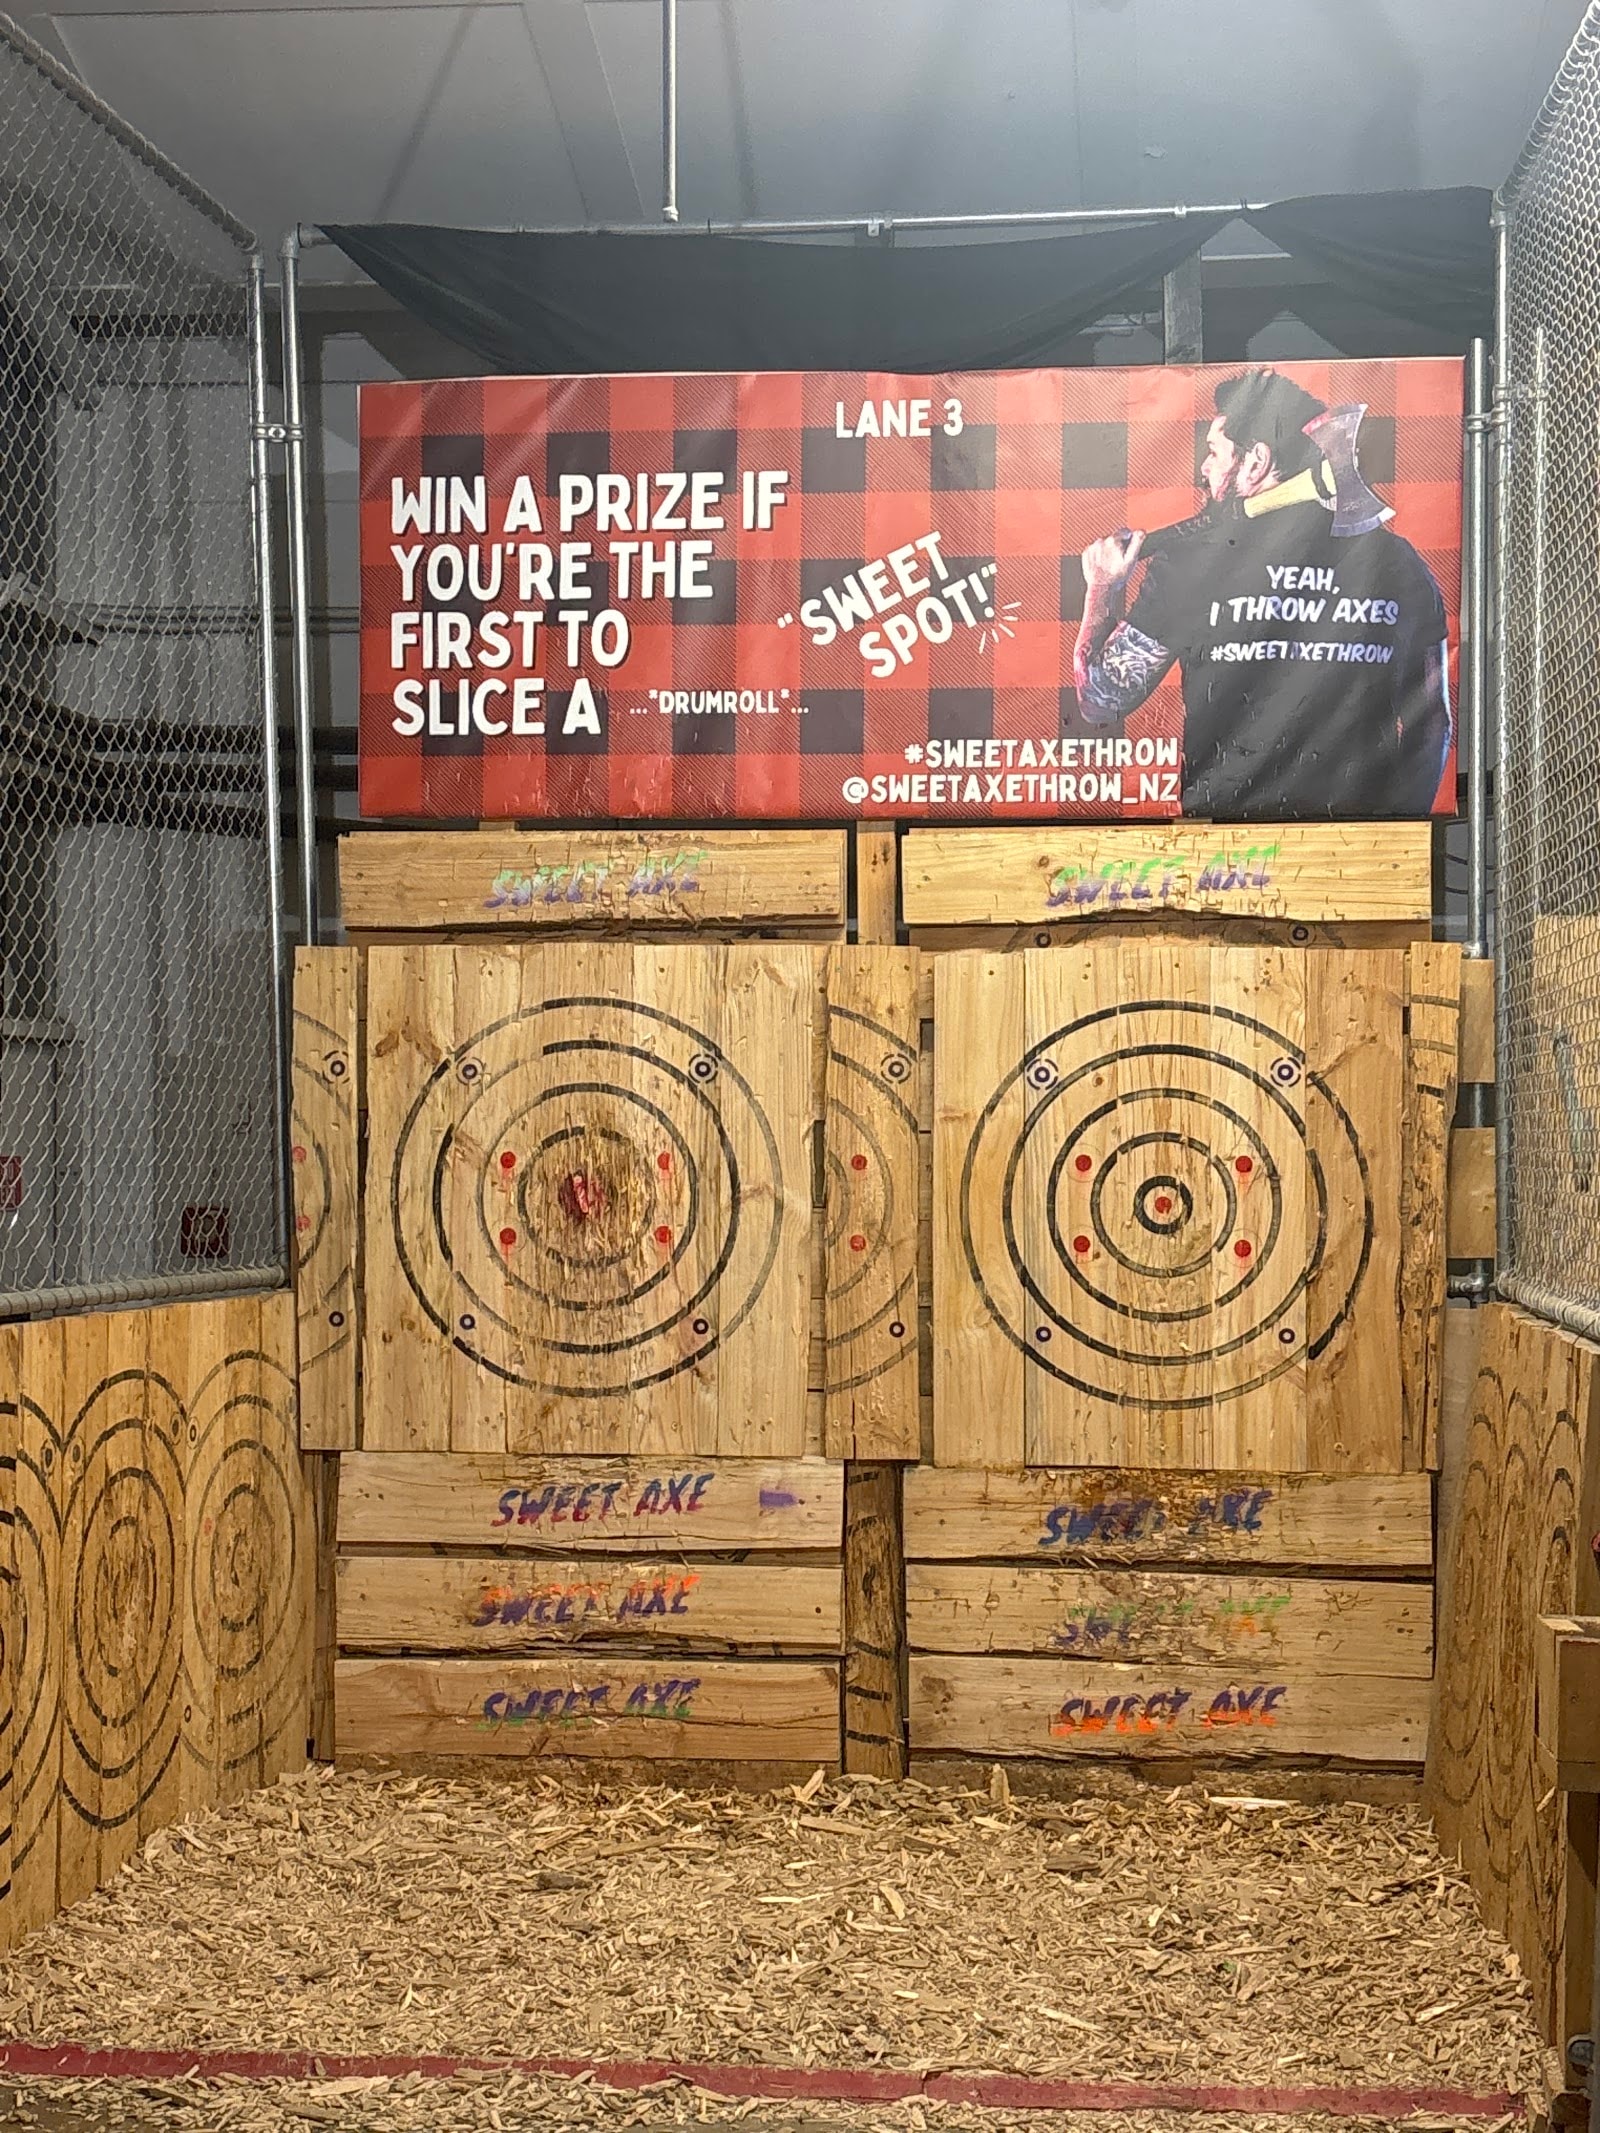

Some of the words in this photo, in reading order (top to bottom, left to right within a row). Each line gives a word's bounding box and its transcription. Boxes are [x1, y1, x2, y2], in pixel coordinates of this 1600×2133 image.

[836, 400, 931, 438] LANE
[943, 399, 964, 436] 3
[391, 475, 487, 534] WIN
[503, 475, 542, 533] A
[559, 471, 724, 533] PRIZE
[742, 470, 788, 530] IF
[390, 541, 593, 601] YOU'RE
[609, 540, 713, 598] THE
[1266, 565, 1341, 594] YEAH,
[1209, 601, 1220, 626] I
[1228, 596, 1326, 623] THROW
[1332, 598, 1399, 625] AXES
[391, 610, 544, 669] FIRST
[558, 609, 630, 667] TO
[391, 678, 545, 736] SLICE
[562, 677, 600, 735] A
[904, 738, 1178, 769] #SWEETAXETHROW
[842, 773, 1180, 805] @SWEETAXETHROW_NZ
[491, 1481, 623, 1527] SWEET
[633, 1473, 715, 1517] AXE
